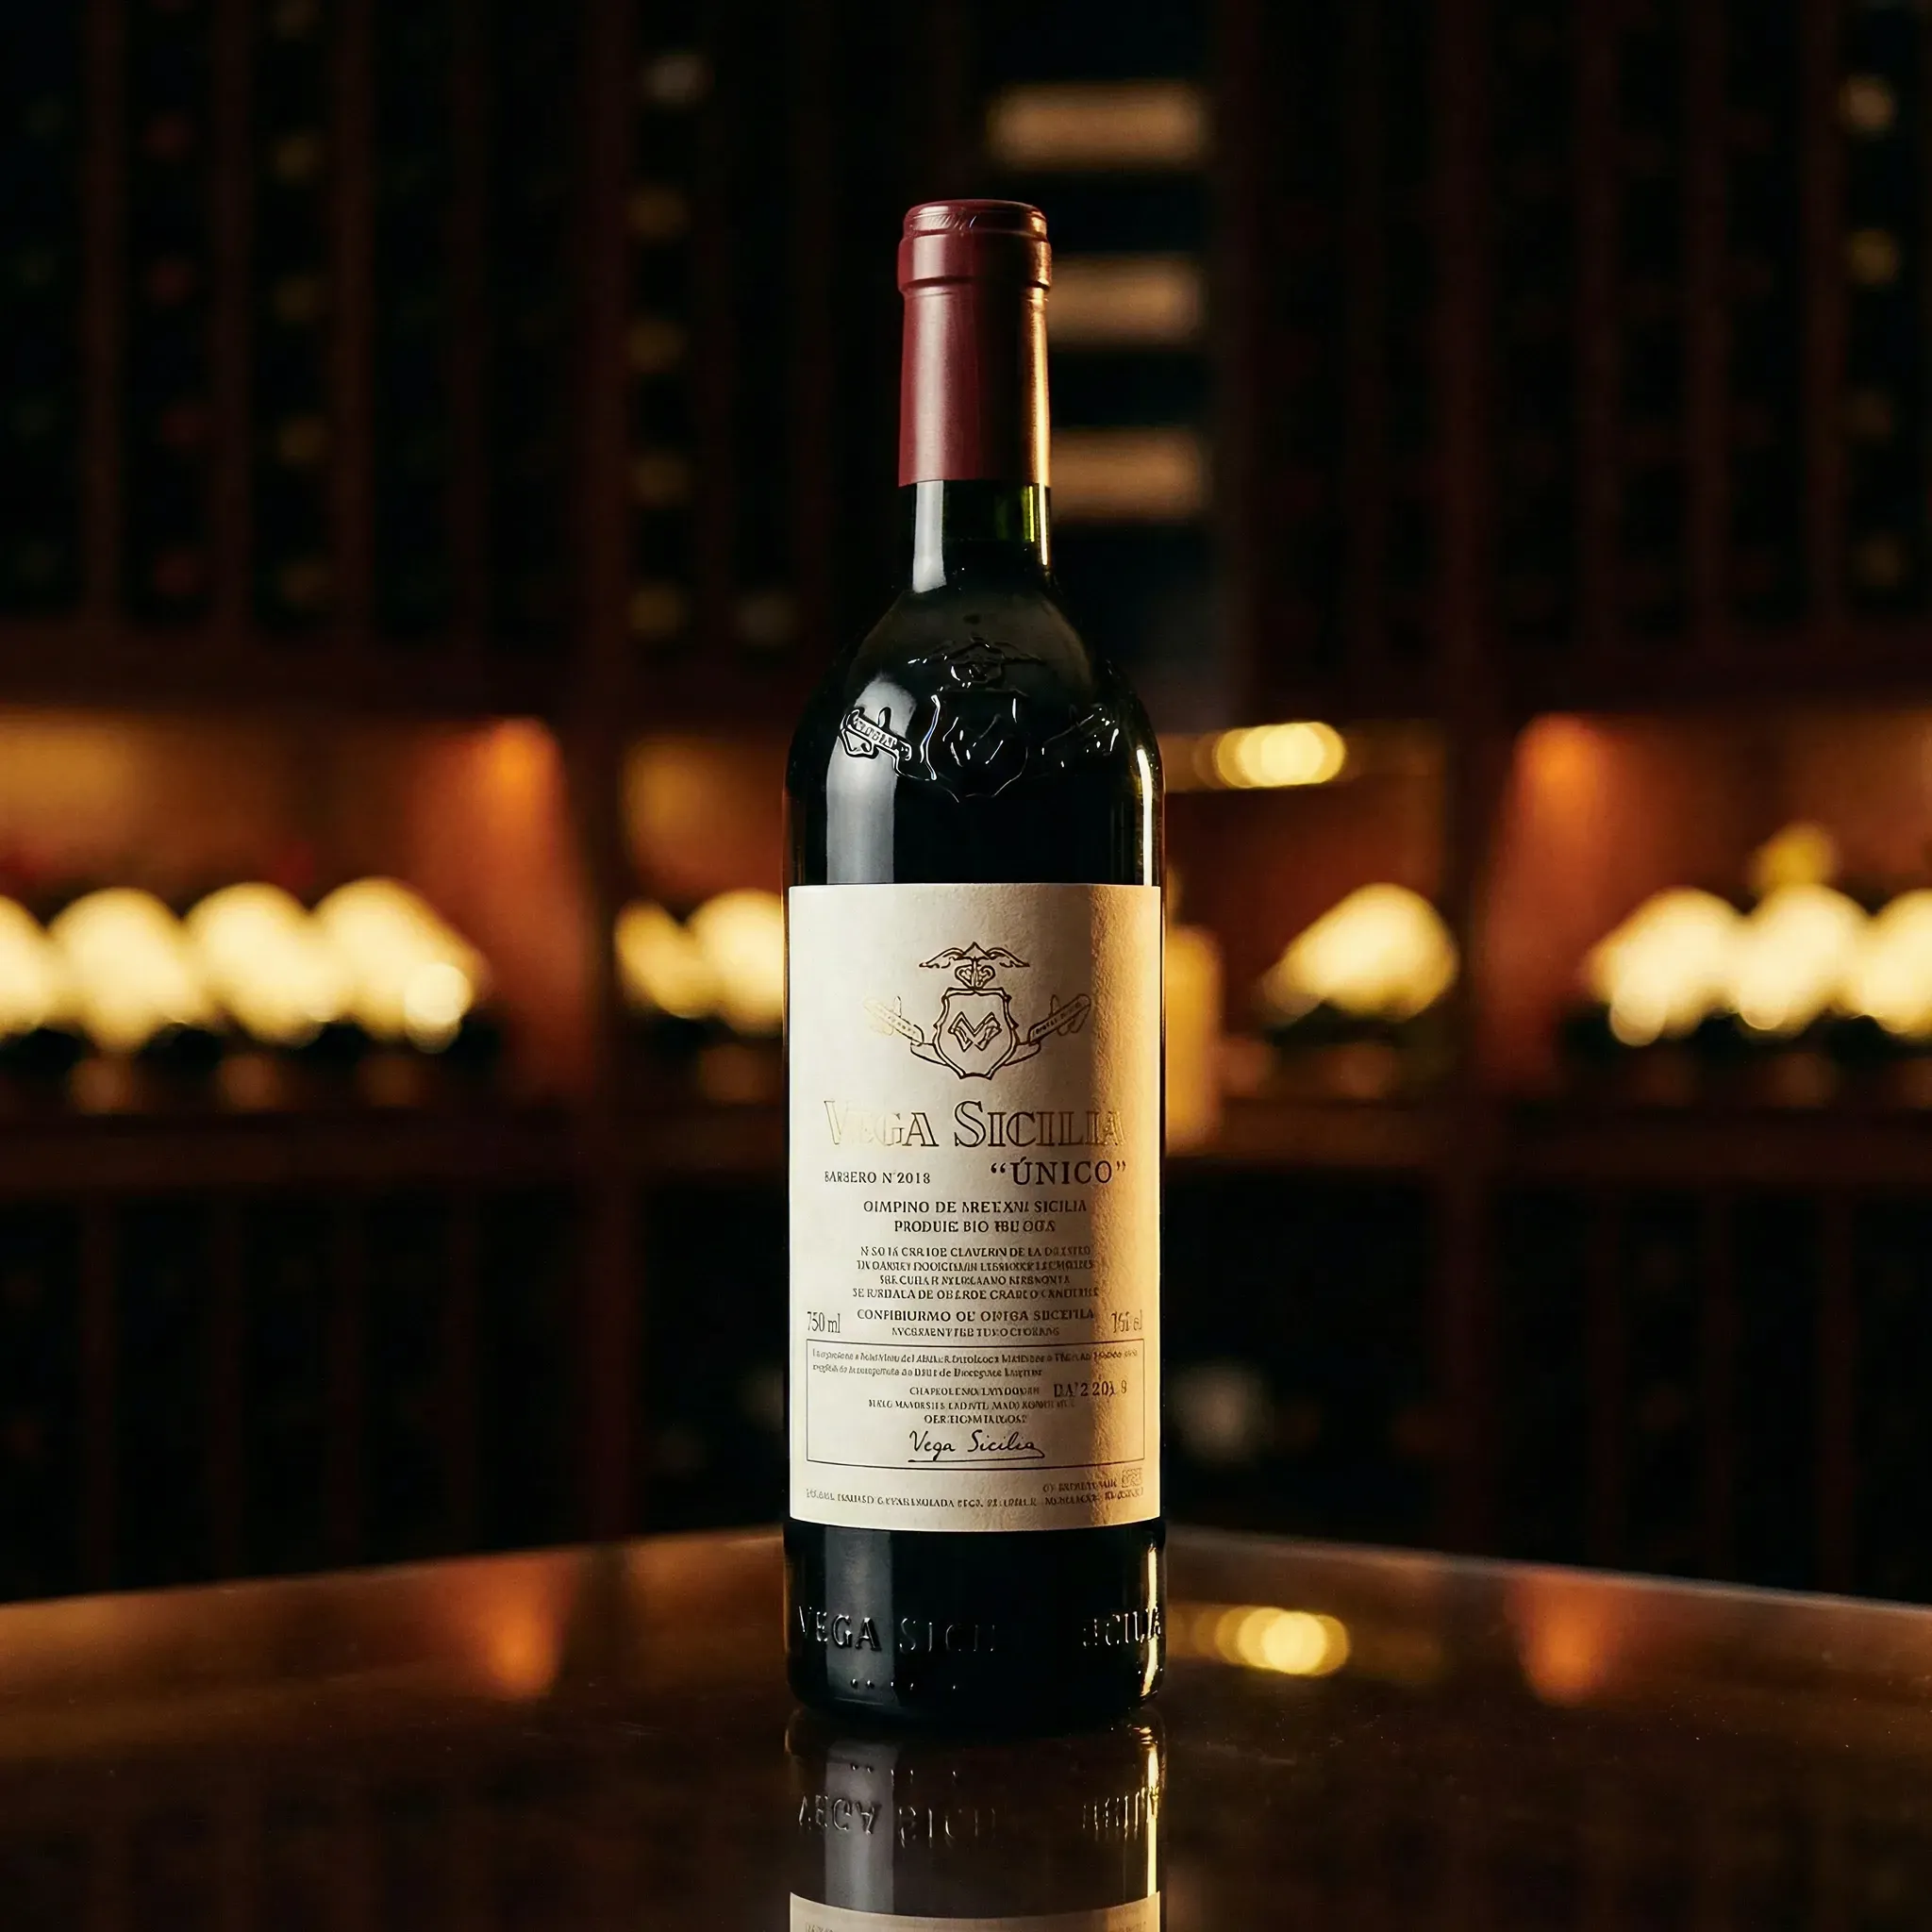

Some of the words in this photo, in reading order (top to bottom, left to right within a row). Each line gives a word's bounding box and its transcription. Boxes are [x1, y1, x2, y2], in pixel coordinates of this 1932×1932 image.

[824, 1100, 940, 1147] VEGA
[954, 1100, 1126, 1148] SICILIA
[935, 1201, 957, 1214] DE
[1034, 1199, 1088, 1213] SICILIA
[909, 1429, 957, 1462] Vega
[967, 1428, 1046, 1459] Sicilia
[798, 1605, 883, 1651] VEGA
